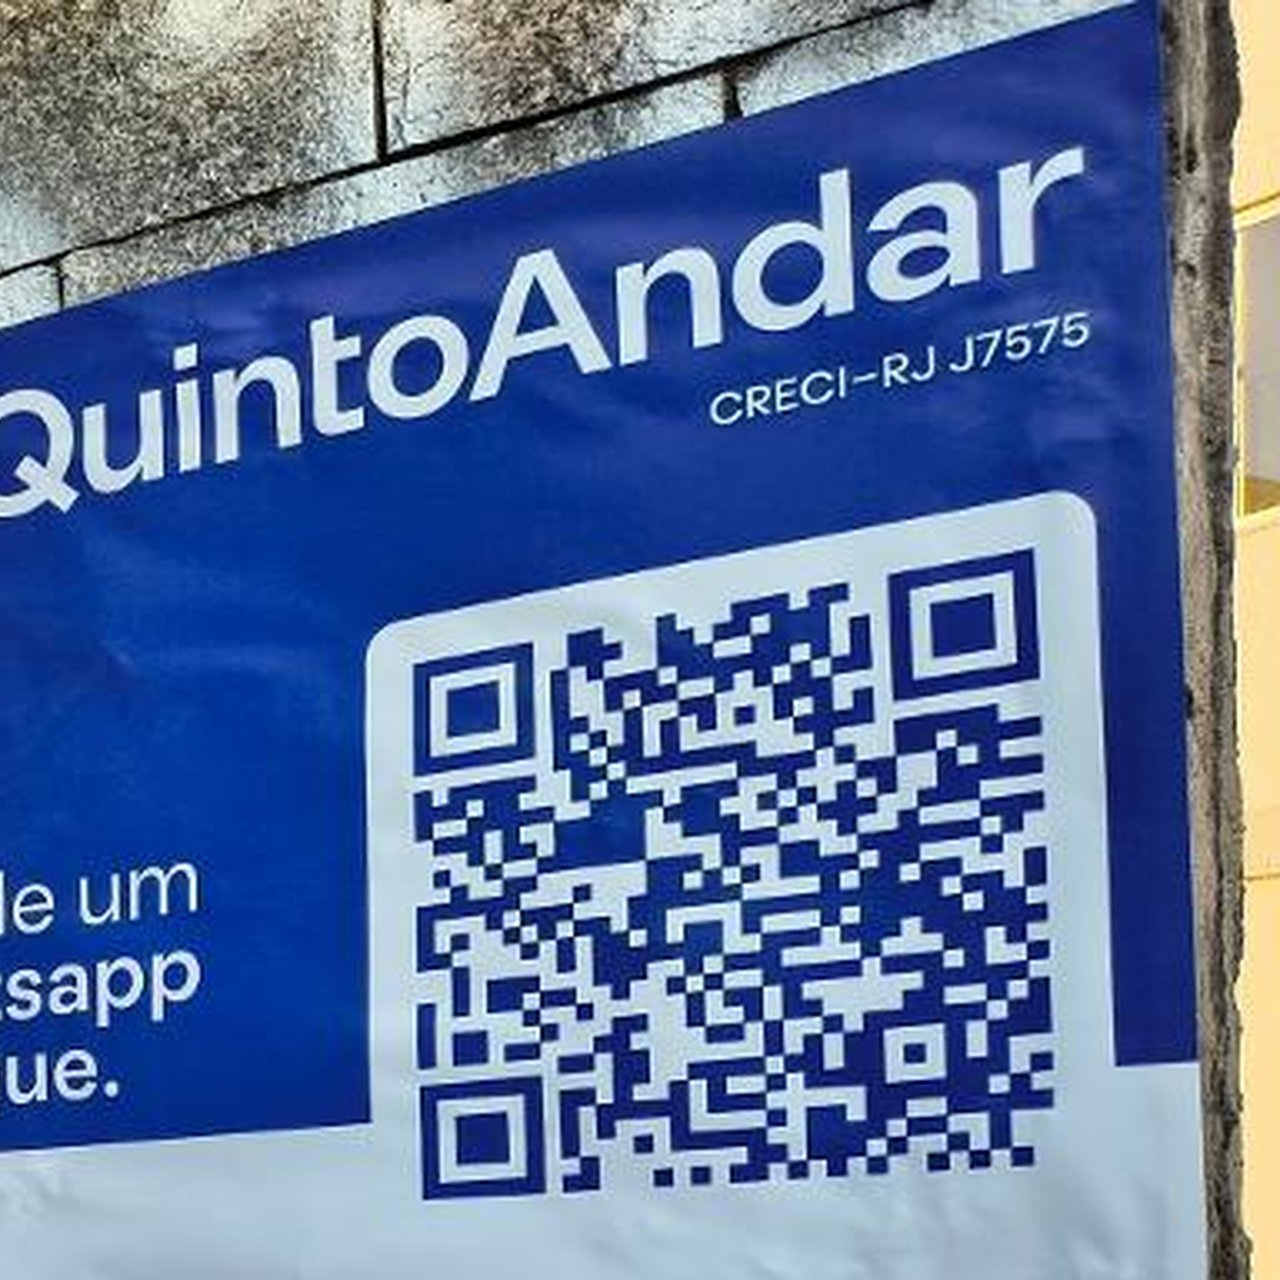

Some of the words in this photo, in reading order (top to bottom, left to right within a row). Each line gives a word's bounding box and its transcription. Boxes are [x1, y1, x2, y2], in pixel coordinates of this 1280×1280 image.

[709, 346, 936, 426] CRECI-RJ
[949, 311, 1090, 373] J7575
[80, 862, 199, 925] um
